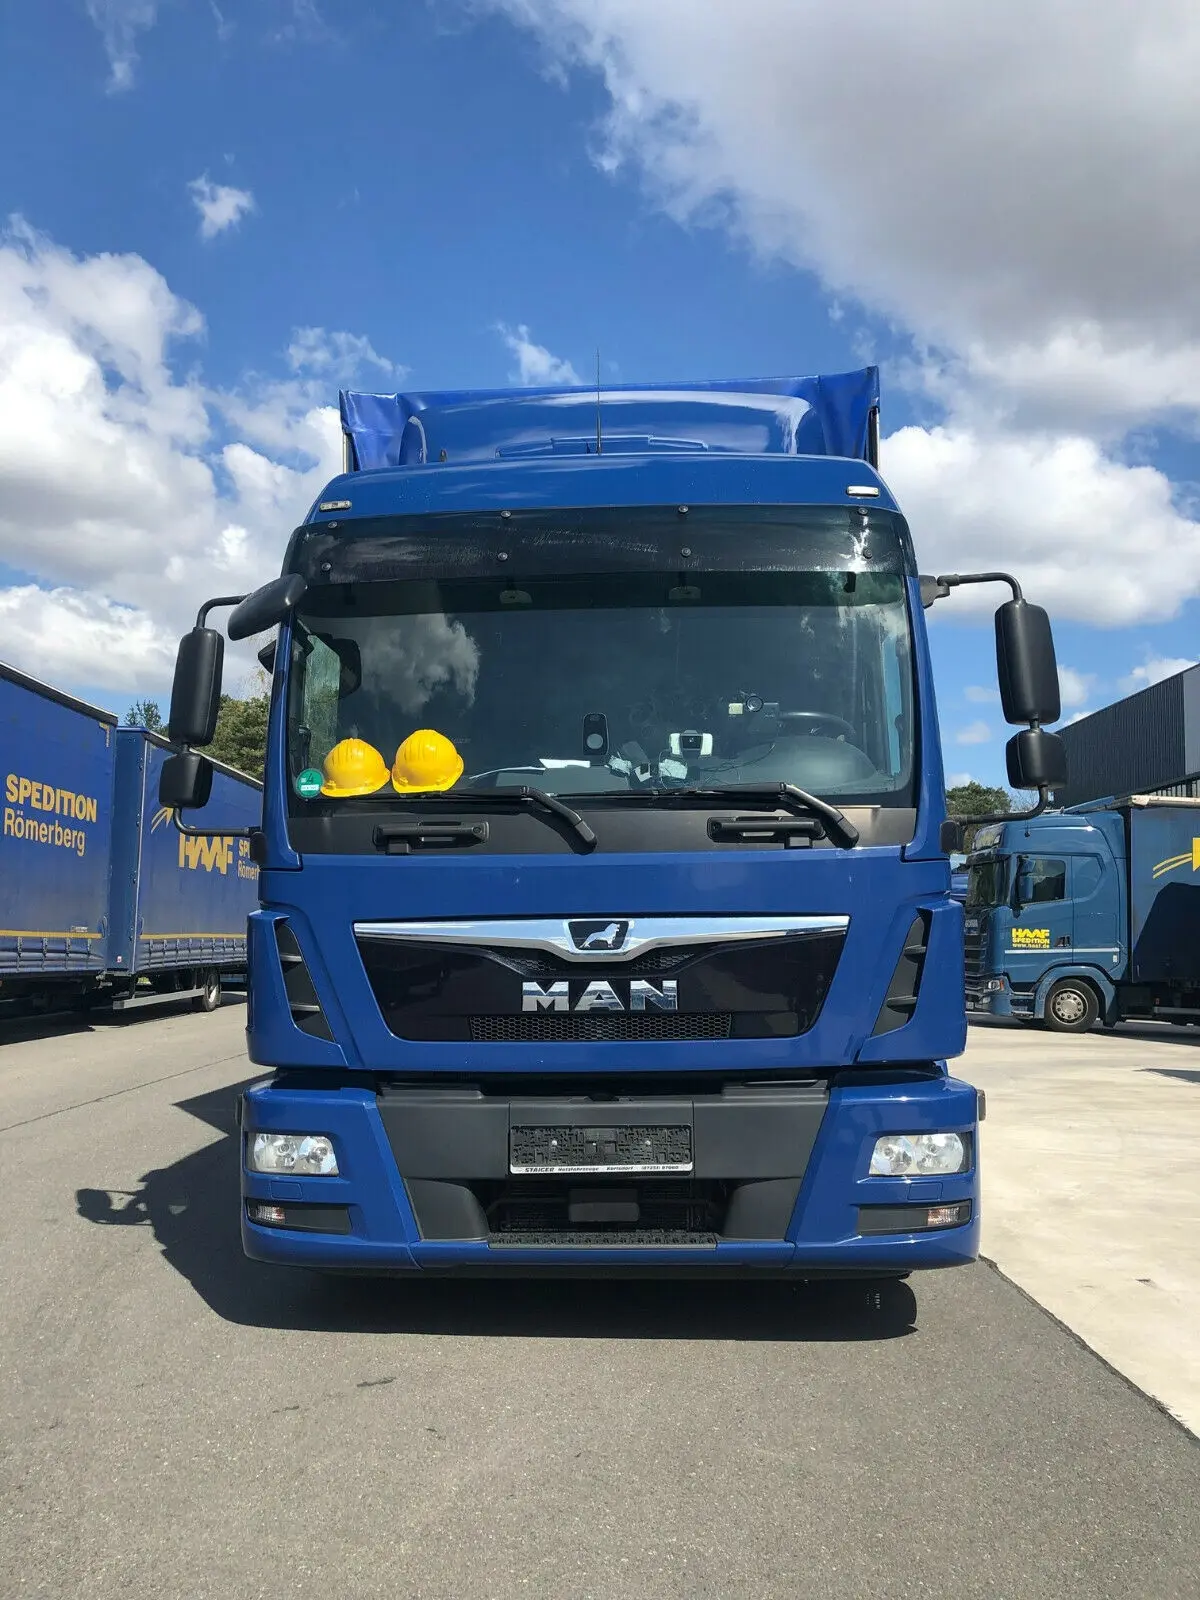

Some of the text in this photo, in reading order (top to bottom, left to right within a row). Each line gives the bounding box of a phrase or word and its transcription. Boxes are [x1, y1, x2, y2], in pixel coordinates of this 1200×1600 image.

[5, 773, 97, 823] SPEDITION
[3, 807, 86, 857] Römerberg
[1011, 927, 1050, 939] HAAF
[522, 980, 678, 1012] MAN
